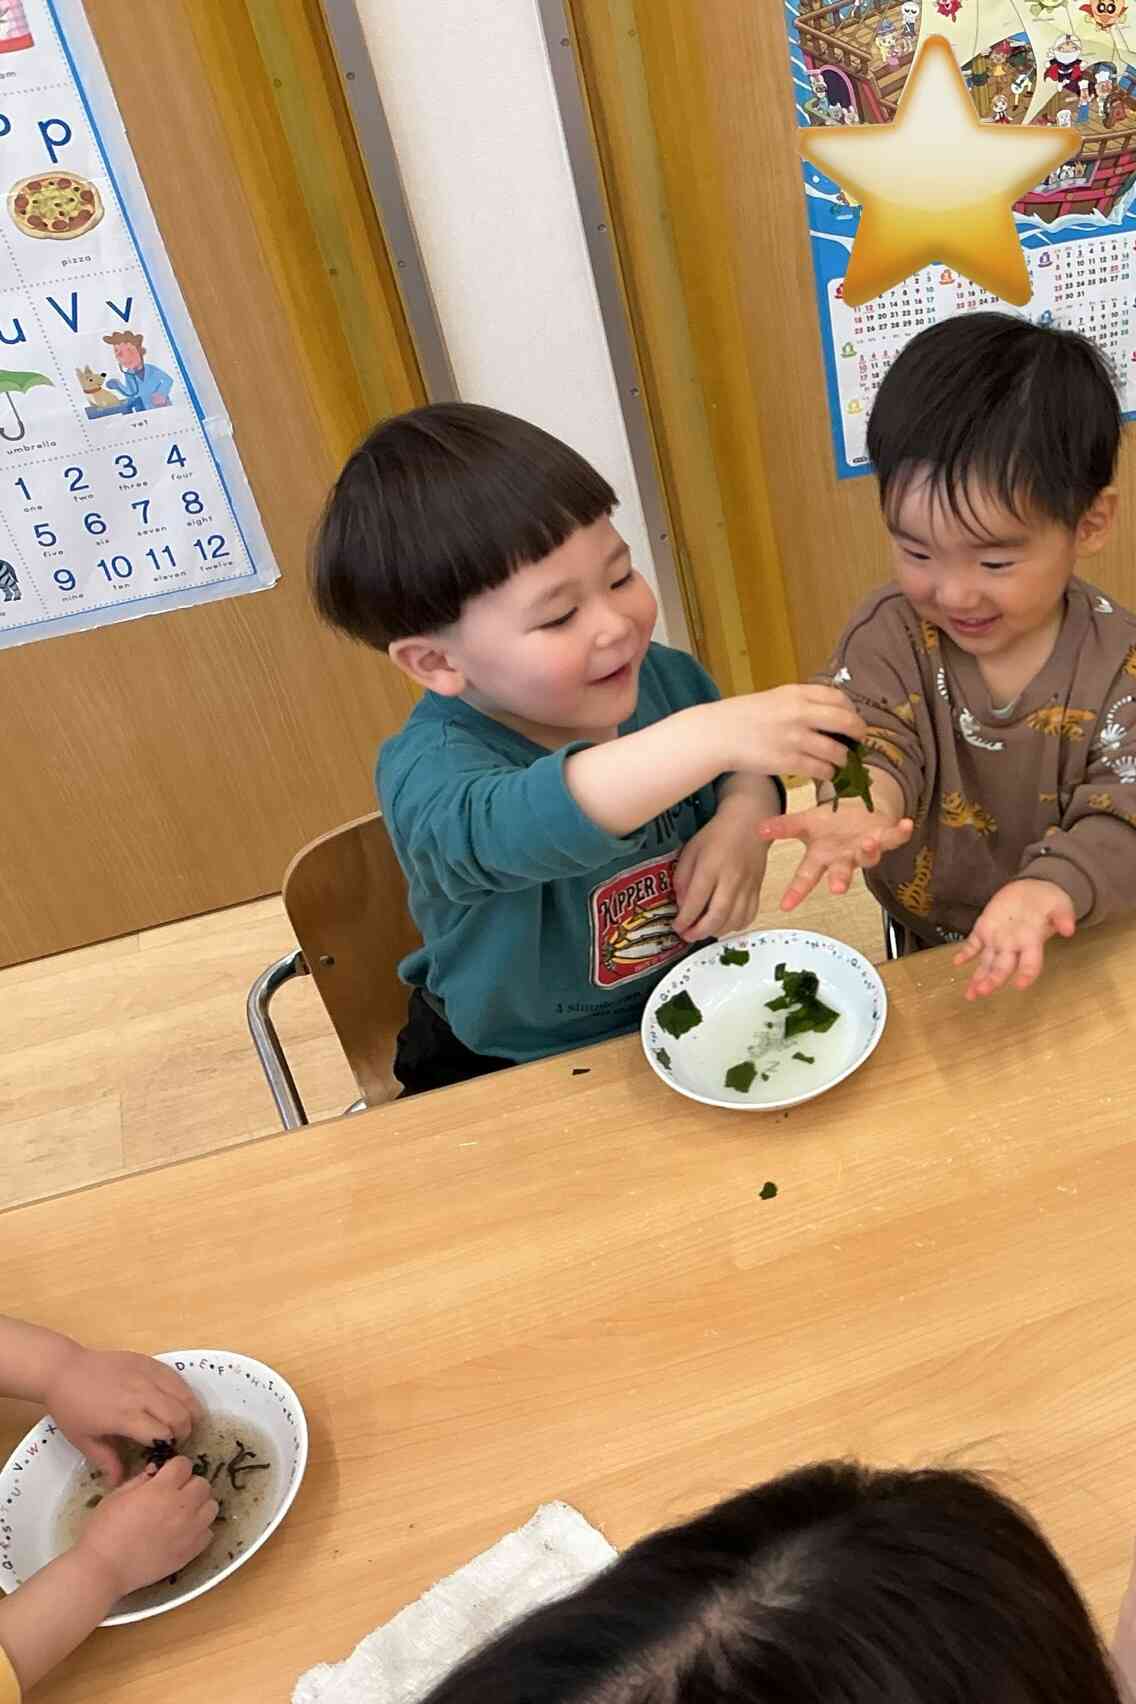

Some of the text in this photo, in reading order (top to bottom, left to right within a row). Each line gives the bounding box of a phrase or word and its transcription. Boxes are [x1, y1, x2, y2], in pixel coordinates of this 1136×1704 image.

[37, 118, 72, 163] p
[61, 255, 92, 266] pizza
[130, 419, 149, 428] vet
[6, 440, 57, 455] umbrella
[14, 444, 187, 500] 1 2 3 4
[24, 472, 193, 513] one two three four
[33, 491, 204, 547] 5 6 7 8
[43, 550, 64, 558] five
[137, 526, 167, 536] seven
[186, 516, 213, 527] eight
[53, 535, 230, 591] 9 10 11 12
[61, 594, 84, 602] nine
[153, 571, 187, 582] eleven
[200, 560, 233, 572] twelve
[600, 870, 670, 928] KIPPER &
